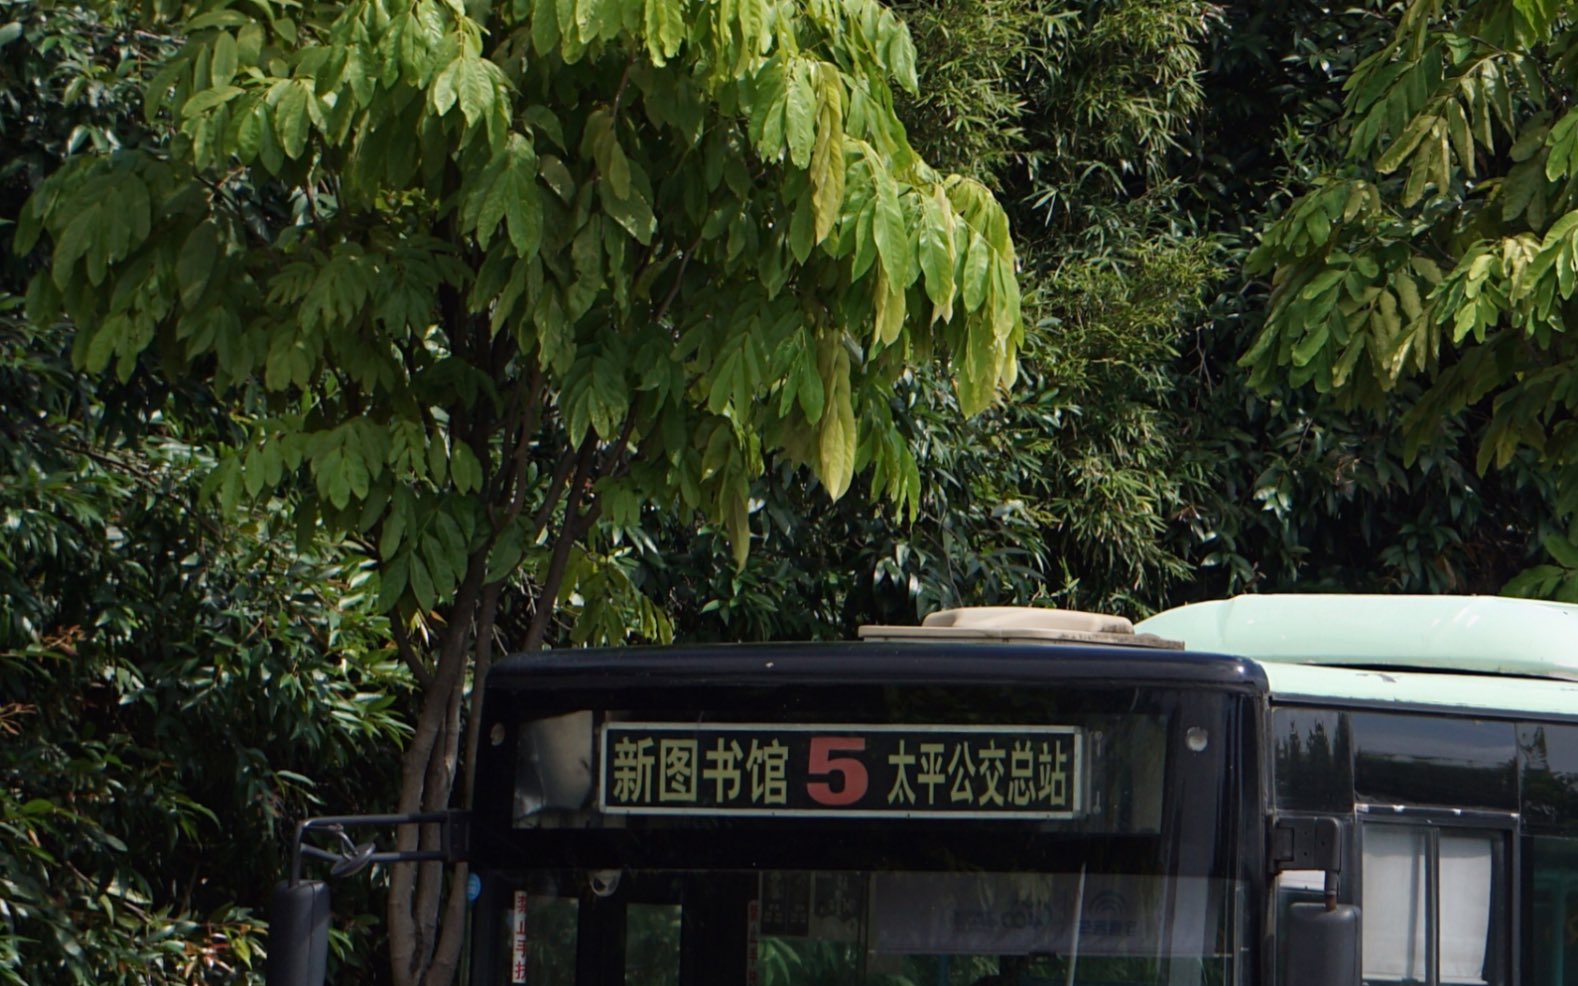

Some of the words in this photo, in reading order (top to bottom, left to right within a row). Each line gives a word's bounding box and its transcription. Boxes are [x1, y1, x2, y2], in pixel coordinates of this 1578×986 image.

[613, 737, 789, 803] 新图书馆
[806, 737, 868, 805] 5
[888, 740, 1068, 806] 太平公交总站
